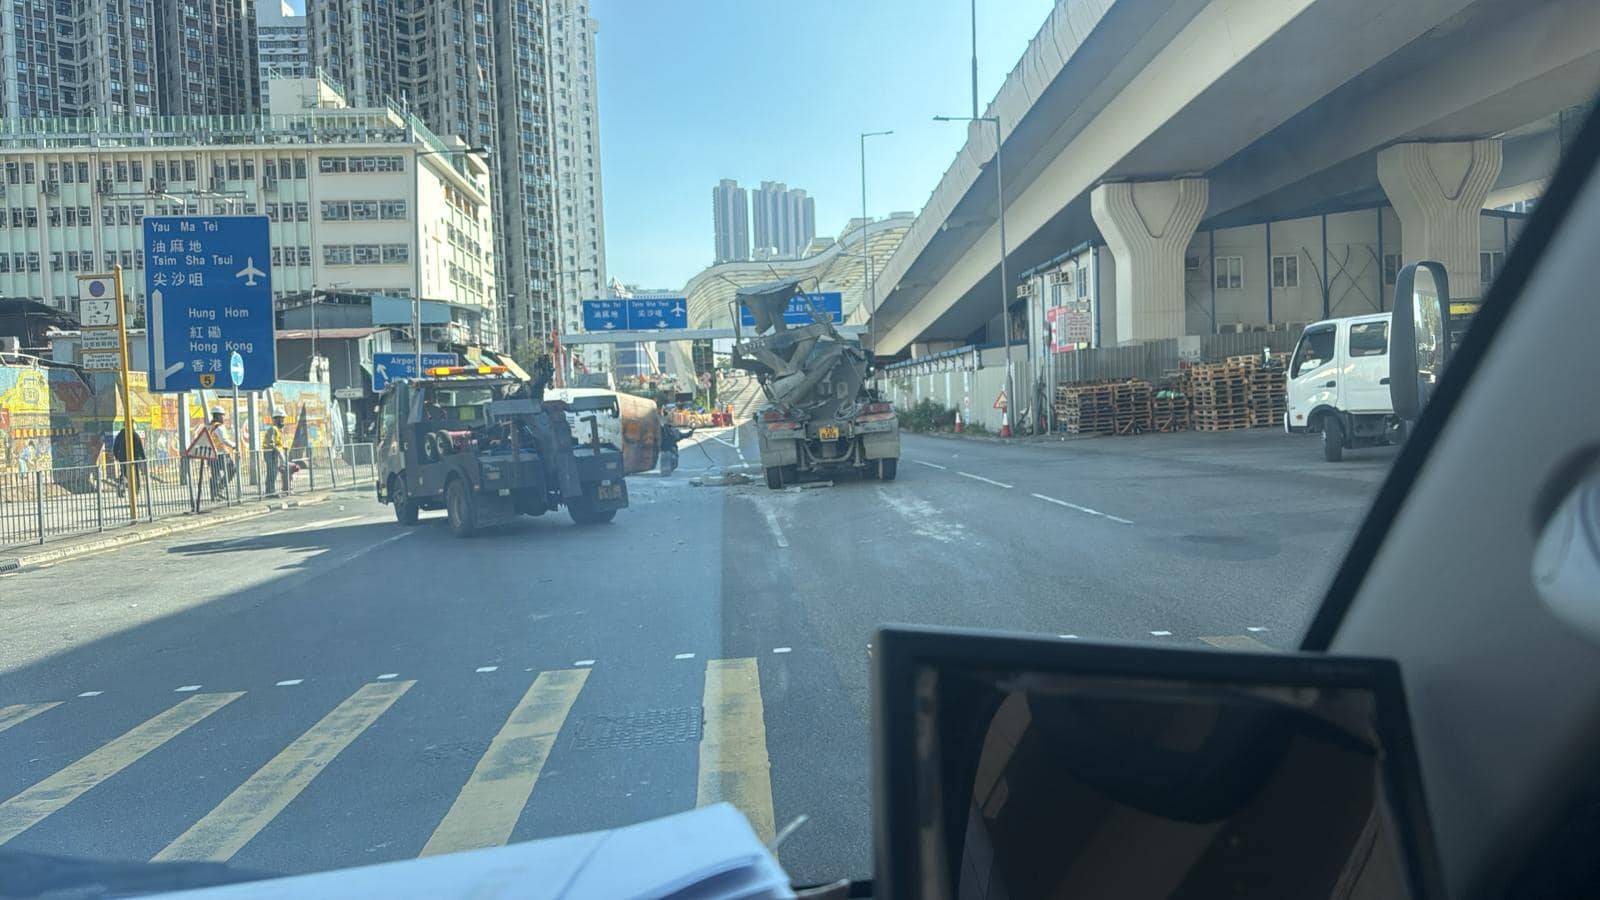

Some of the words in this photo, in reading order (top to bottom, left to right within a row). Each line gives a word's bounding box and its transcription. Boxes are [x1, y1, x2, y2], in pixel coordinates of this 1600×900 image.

[152, 221, 170, 233] Yau
[180, 221, 196, 232] Ma
[203, 221, 219, 232] Tei
[152, 239, 202, 253] 油麻地
[152, 255, 177, 266] Tsim
[185, 255, 205, 266] Sha
[212, 255, 233, 265] Tsui
[153, 272, 204, 287] 尖沙咀
[103, 301, 110, 311] 7
[103, 314, 111, 323] 7
[189, 308, 216, 320] Hung
[224, 307, 249, 318] Hom
[190, 341, 218, 353] Hong
[225, 341, 253, 353] Kong
[191, 358, 223, 372] 香港
[423, 357, 454, 366] Express
[203, 375, 211, 385] 5
